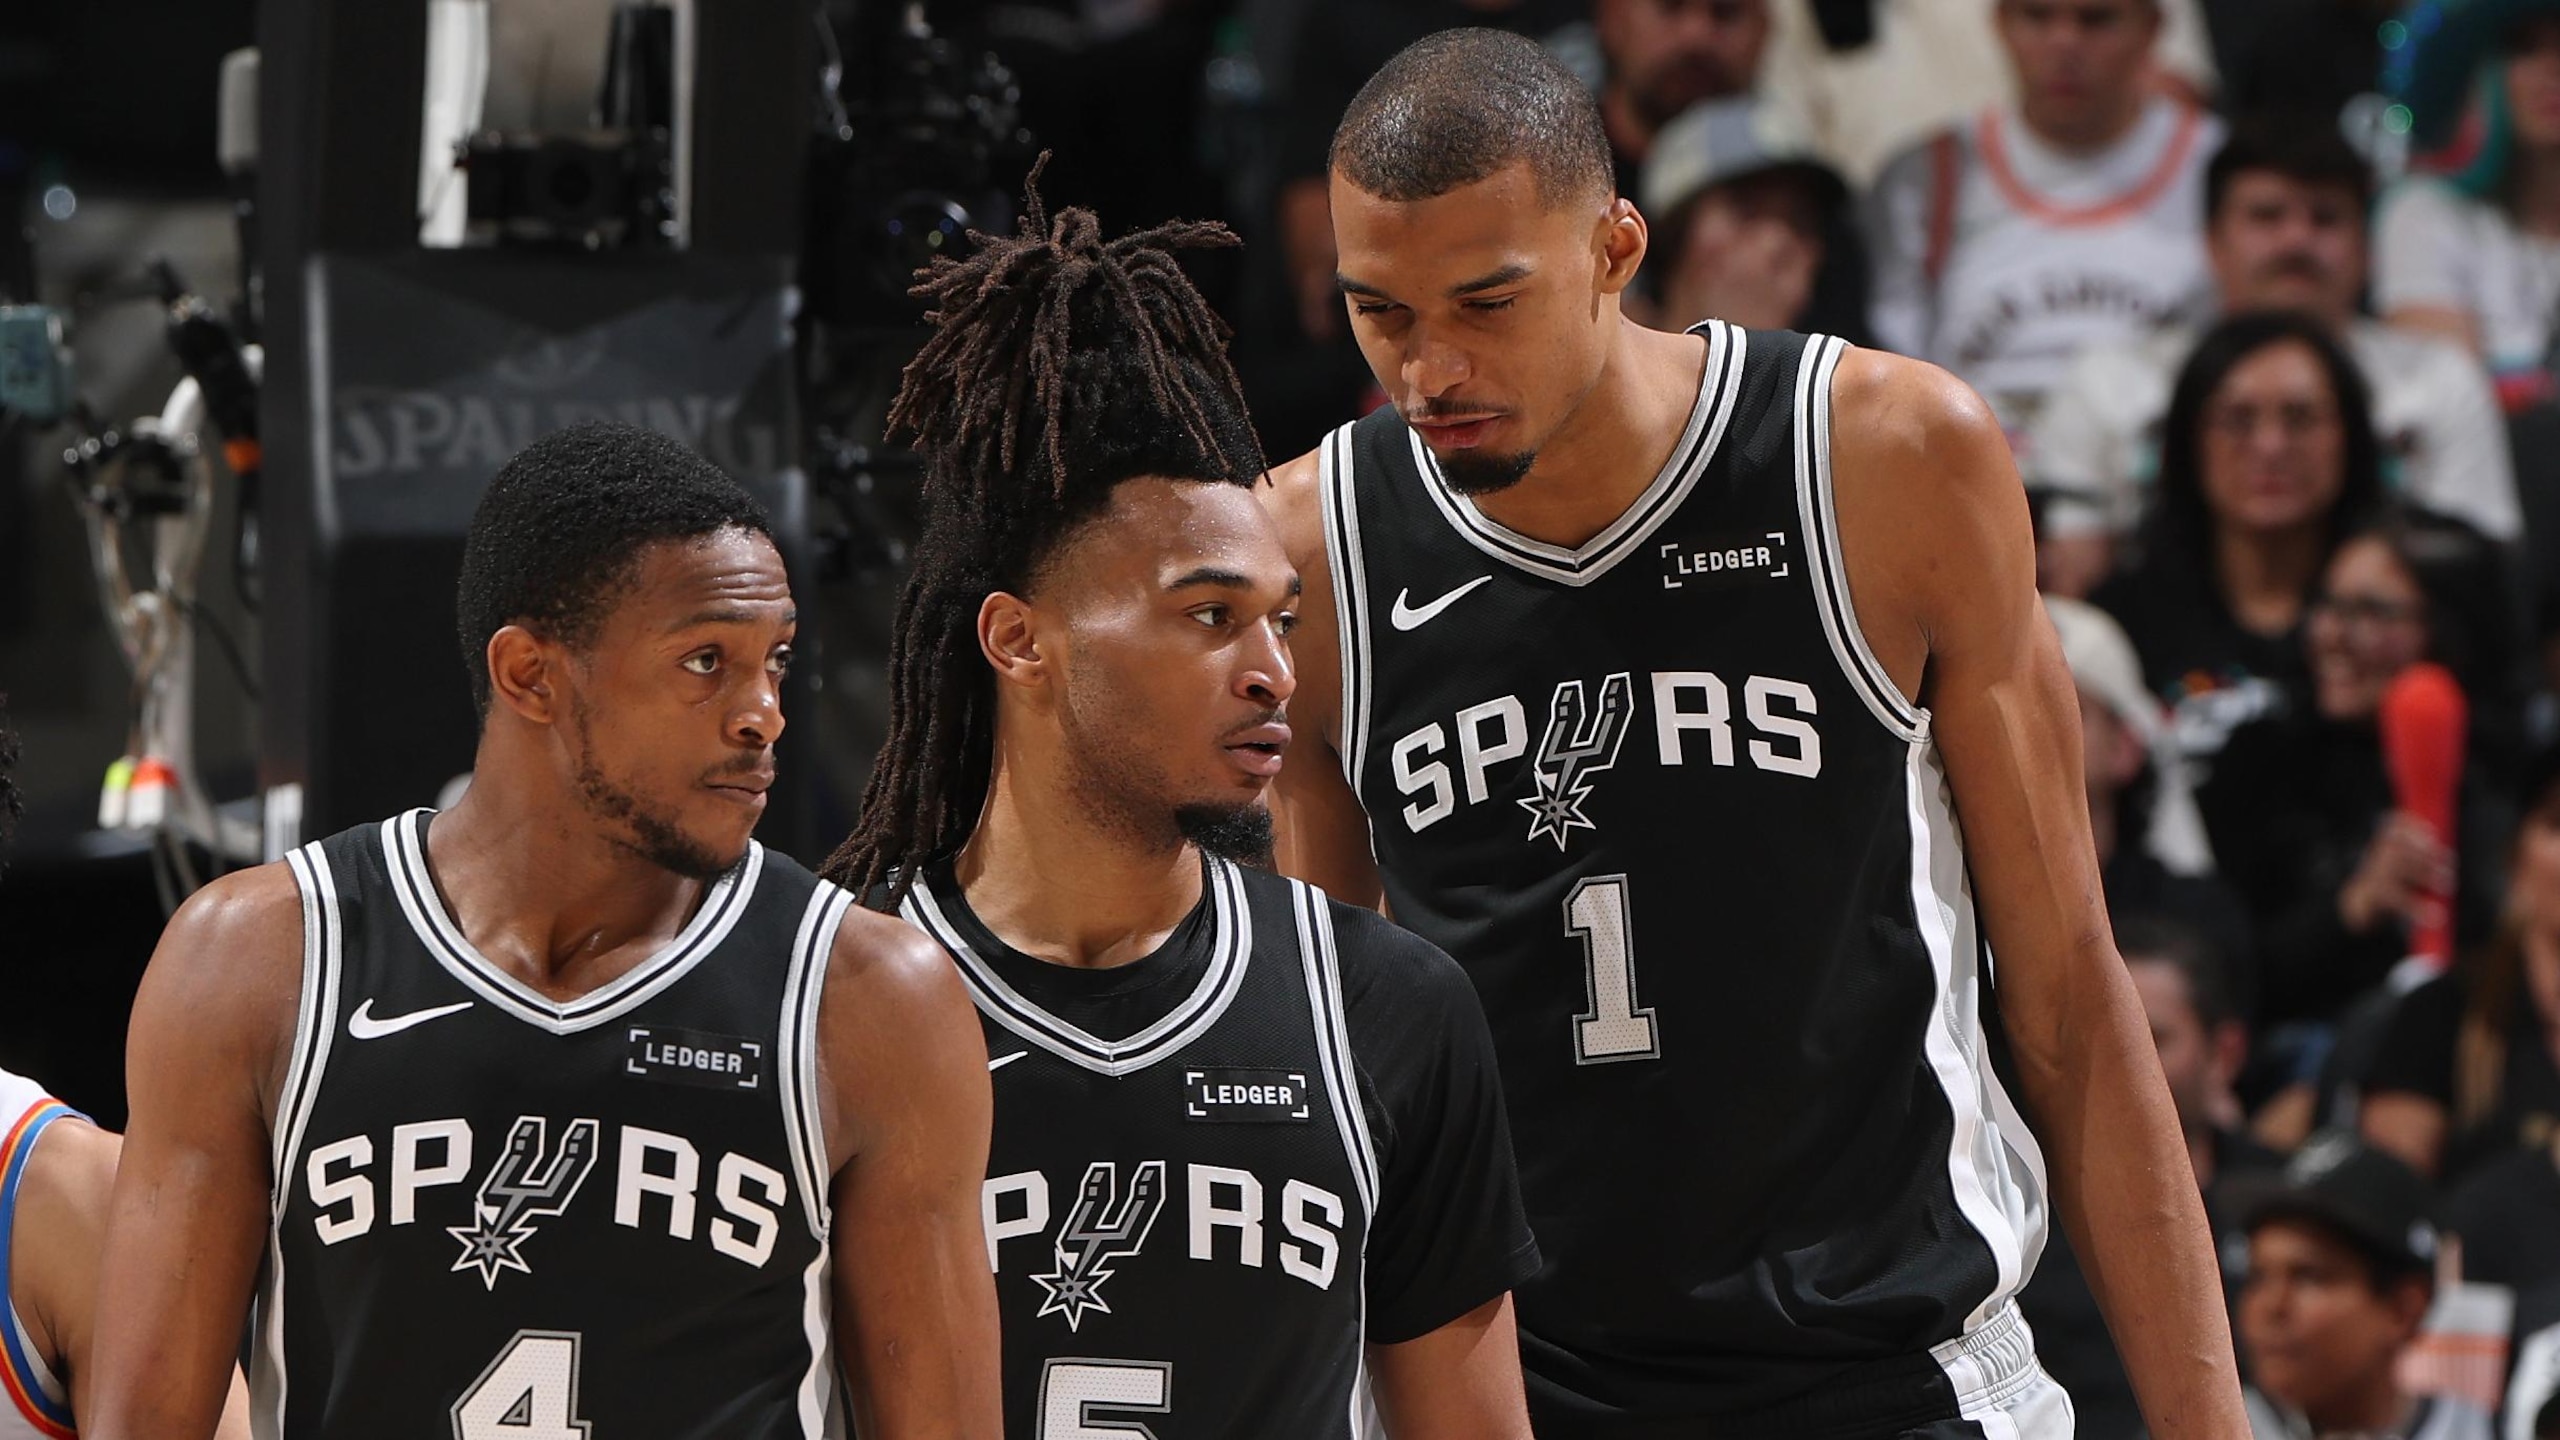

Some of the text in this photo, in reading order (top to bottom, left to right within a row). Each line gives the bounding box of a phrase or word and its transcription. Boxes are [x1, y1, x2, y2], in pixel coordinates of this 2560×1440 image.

[1677, 546, 1771, 575] LEDGER
[1391, 671, 1822, 852] SPURS
[1562, 873, 1661, 1066] 1
[645, 1042, 743, 1074] LEDGER
[1202, 1084, 1293, 1105] LEDGER
[306, 1115, 787, 1292] SPURS
[981, 1160, 1344, 1333] PURS
[449, 1328, 593, 1440] 4
